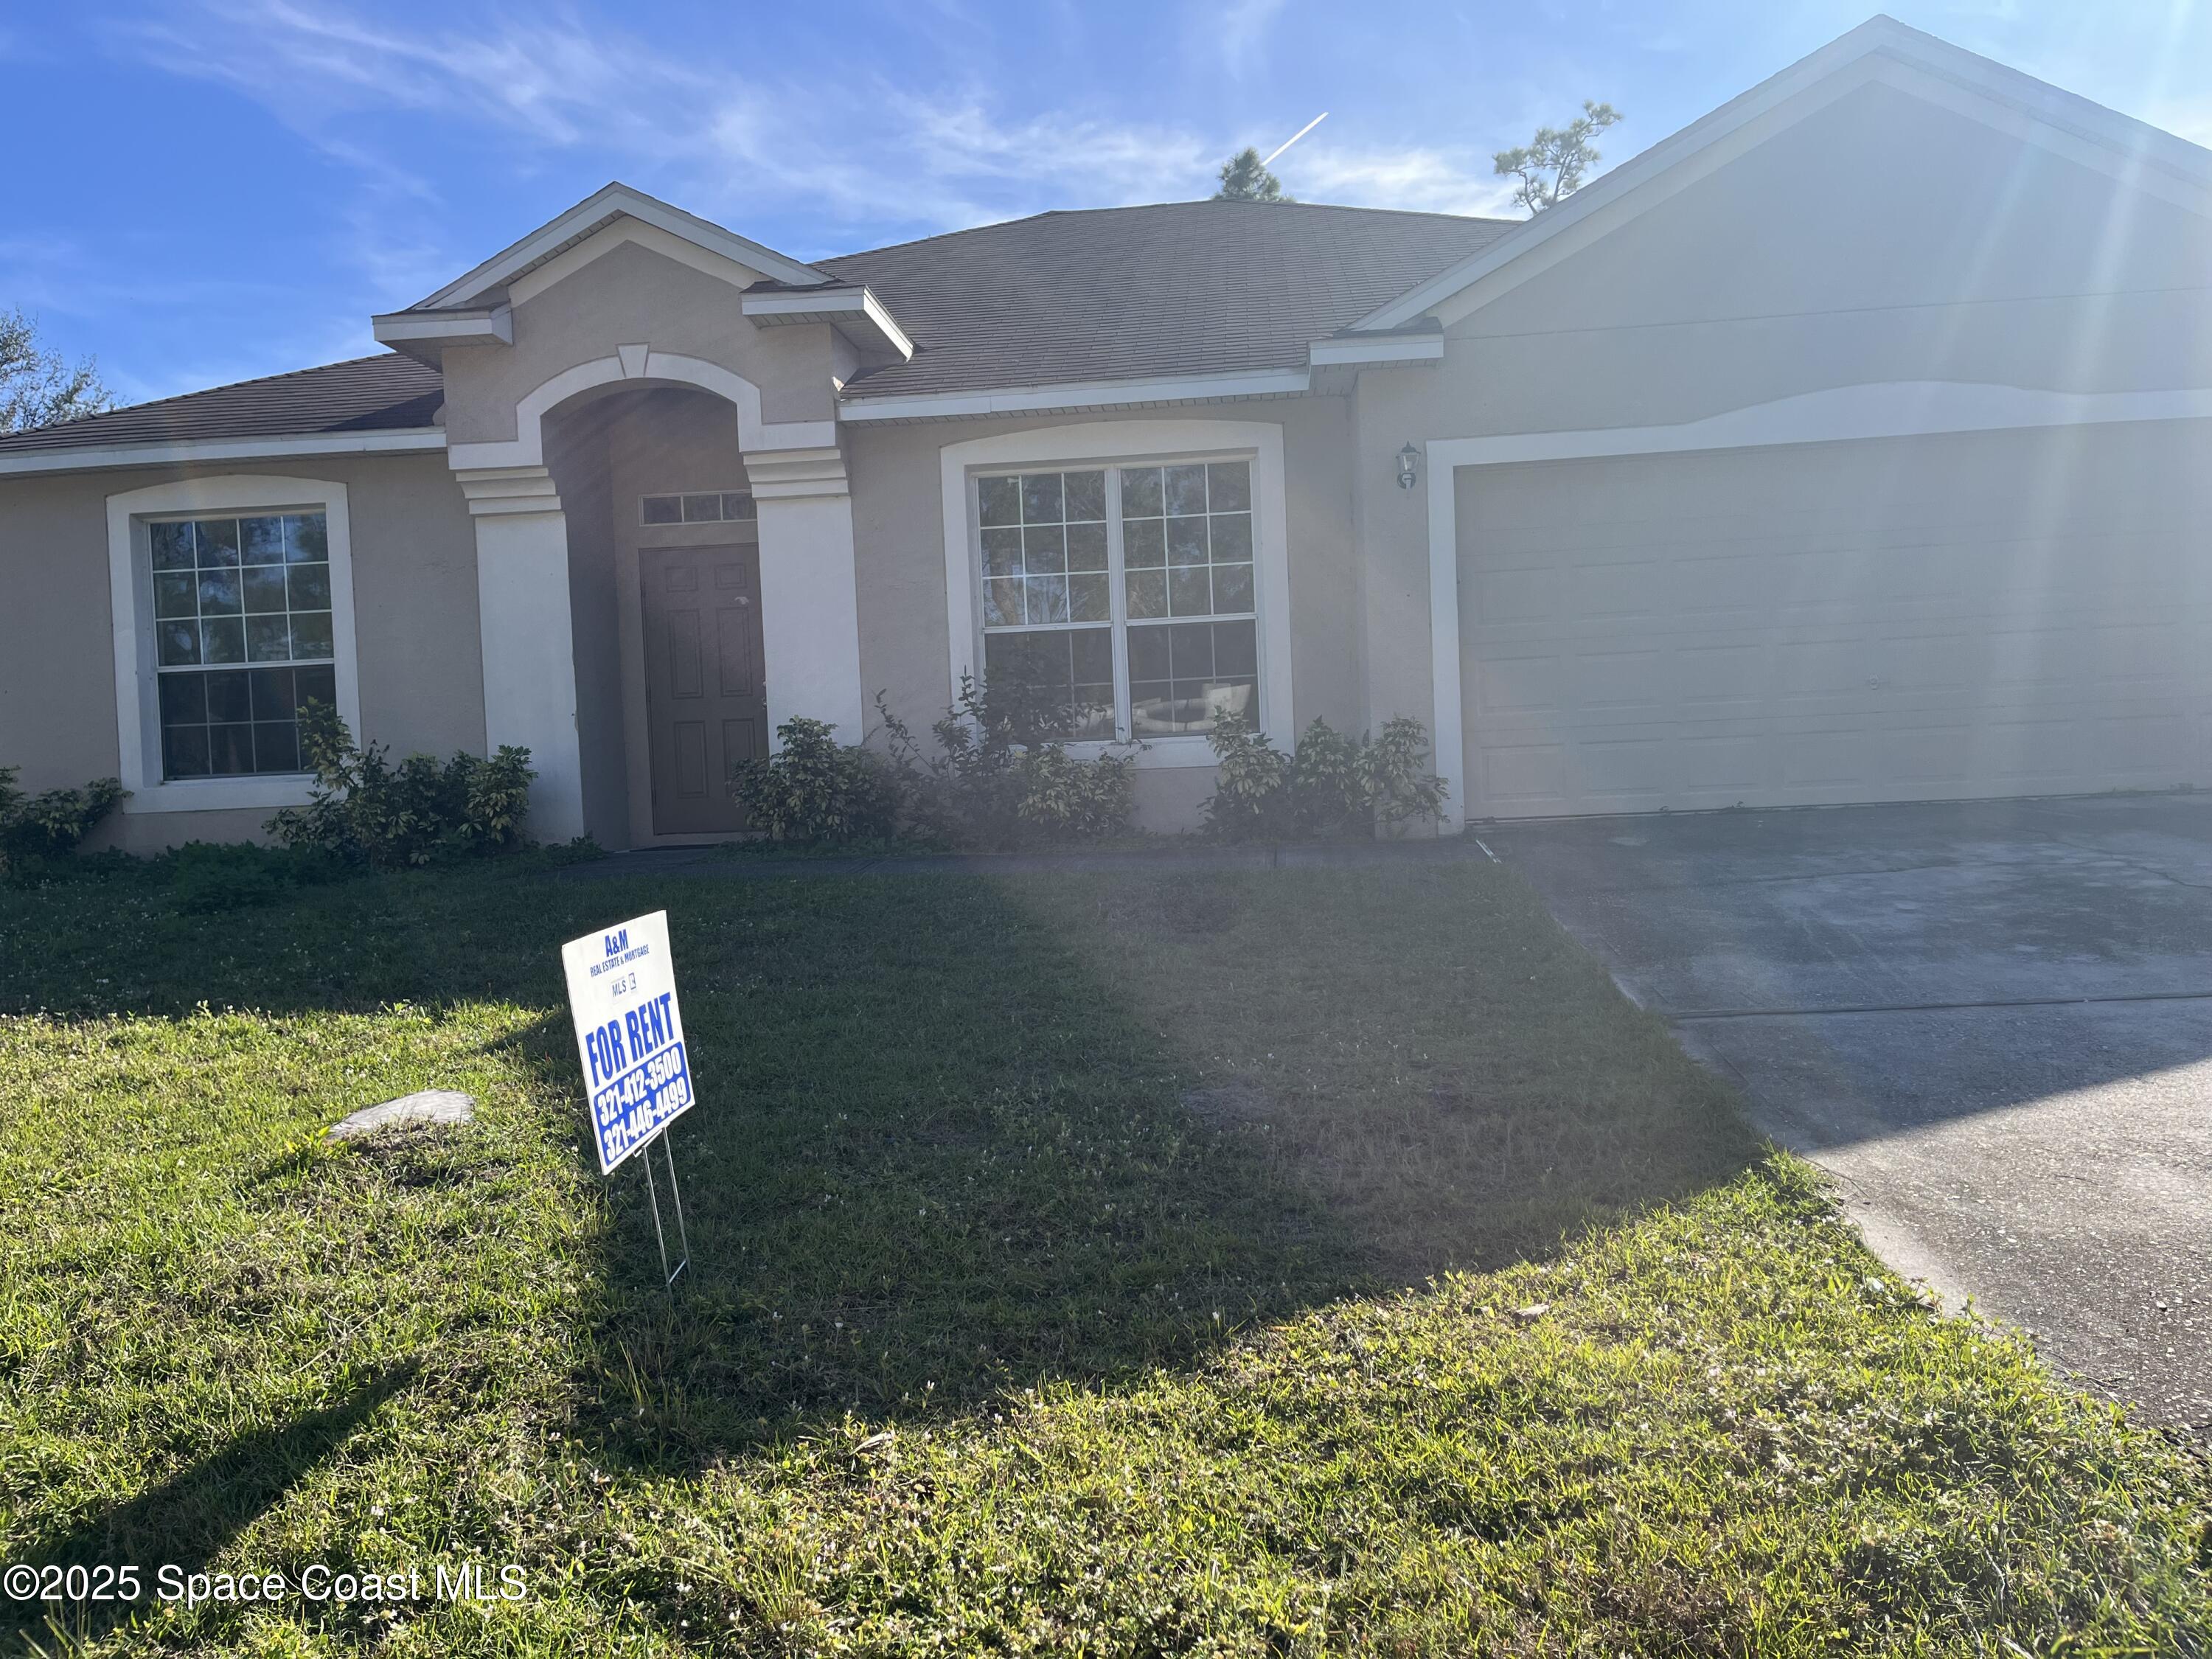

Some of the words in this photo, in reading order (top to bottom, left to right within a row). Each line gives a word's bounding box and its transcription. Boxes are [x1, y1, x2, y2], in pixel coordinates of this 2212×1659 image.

[590, 963, 602, 978] REAL
[602, 956, 620, 973] ESTATE
[619, 956, 625, 965] &
[624, 944, 650, 963] MORTGAGE
[605, 928, 629, 957] A&M
[611, 979, 627, 998] MLS
[585, 1019, 627, 1088] FOR
[625, 992, 674, 1063] RENT
[597, 1047, 682, 1126] 321-412-3500
[603, 1077, 687, 1161] 321-446-4499
